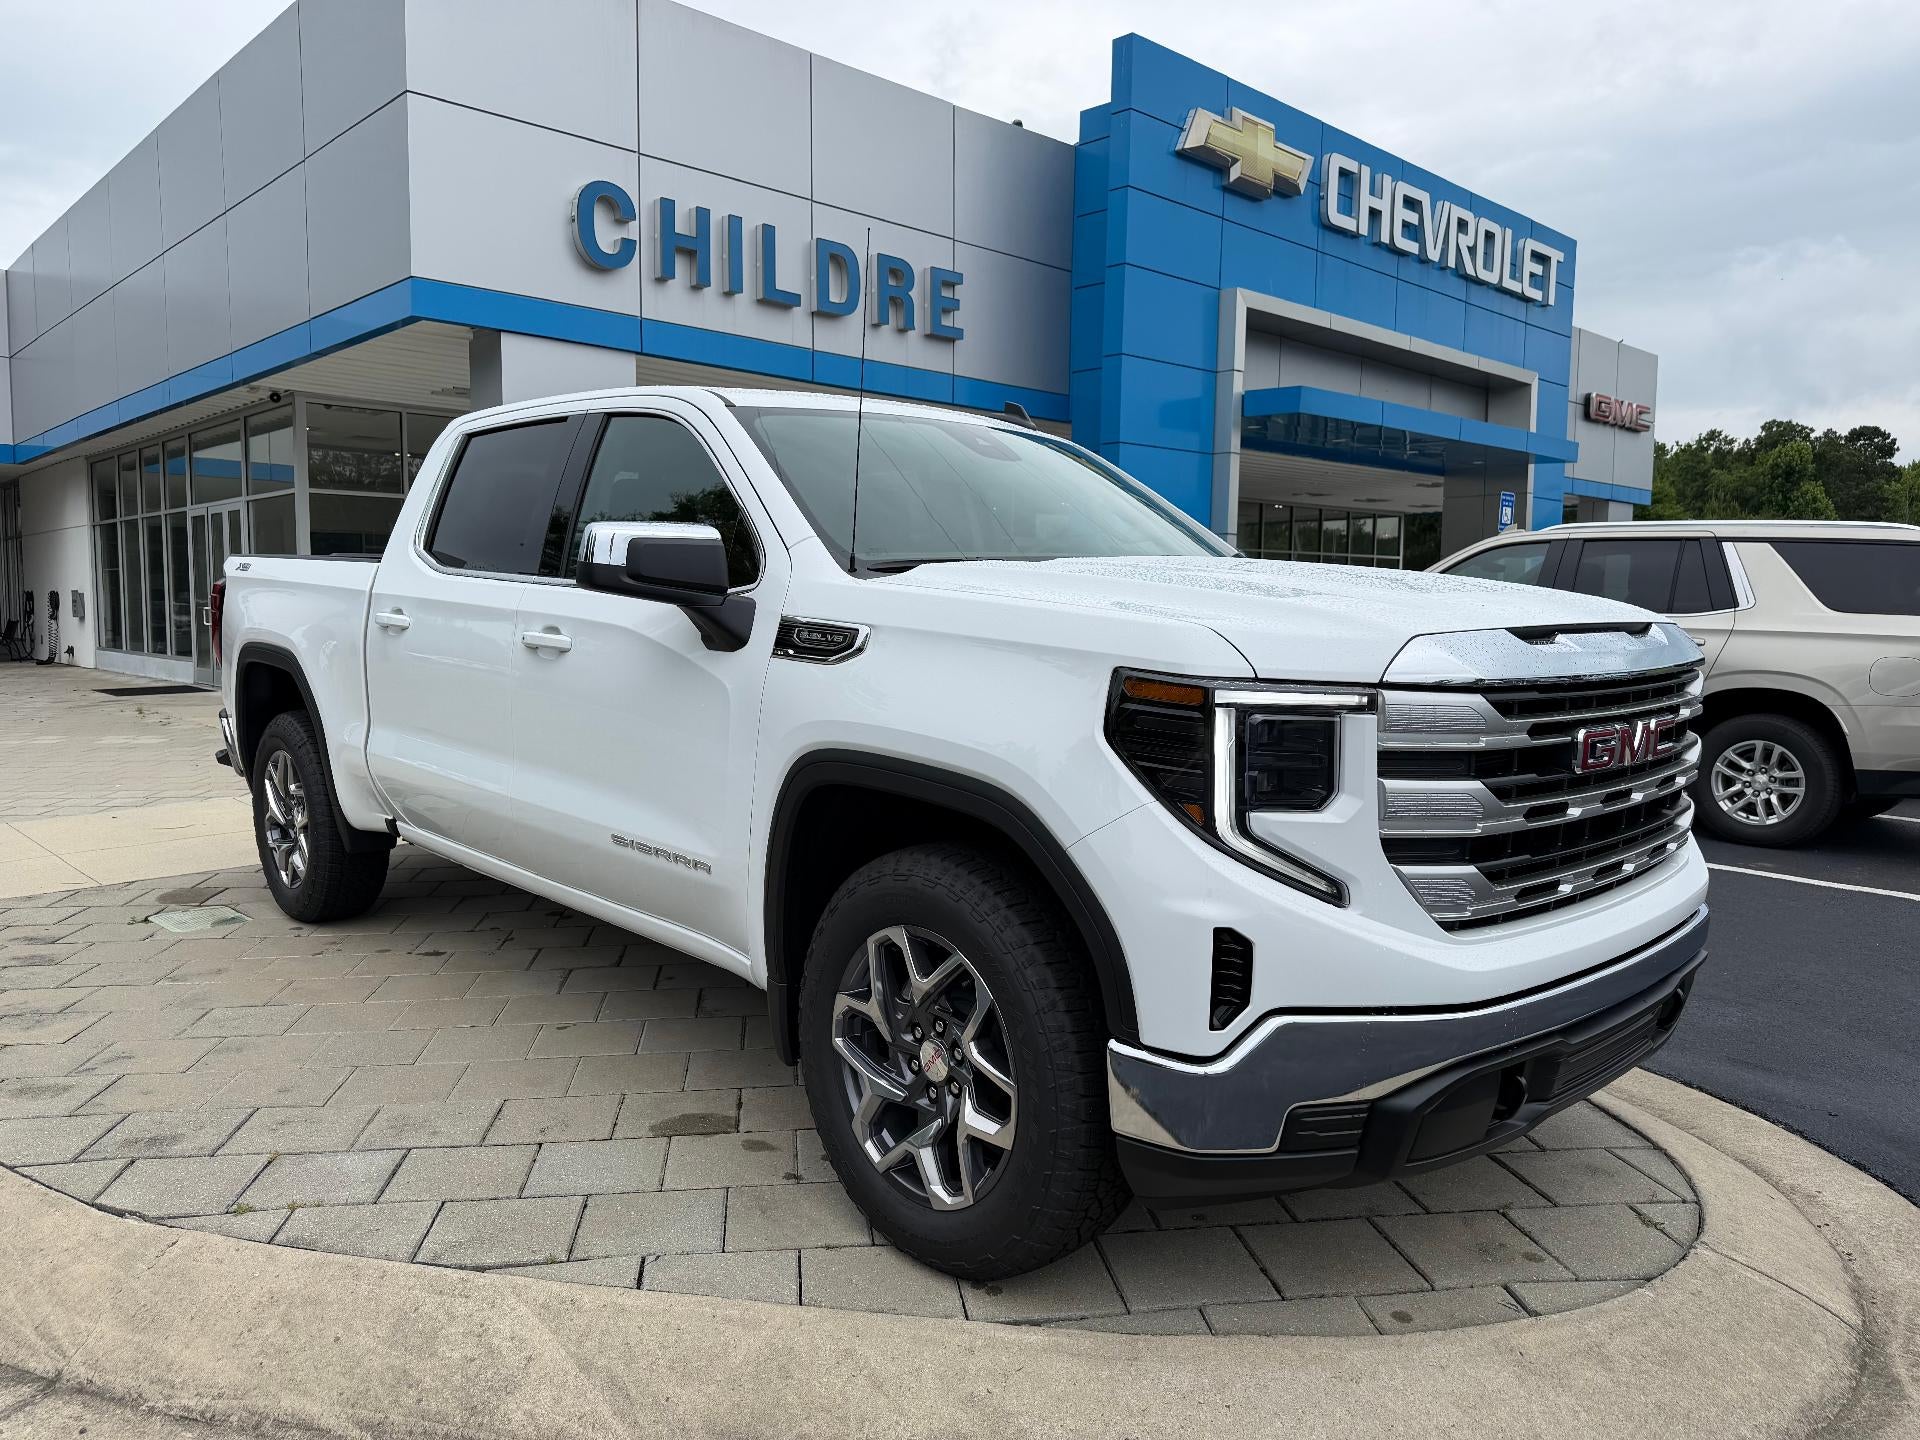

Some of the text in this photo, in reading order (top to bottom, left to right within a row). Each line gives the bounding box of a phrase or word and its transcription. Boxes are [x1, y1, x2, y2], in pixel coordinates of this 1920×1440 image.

[1321, 152, 1565, 306] CHEVROLET
[572, 180, 964, 341] CHILDRE
[1584, 391, 1651, 432] GMC
[1575, 716, 1678, 774] GMC
[610, 833, 713, 875] SIERRA
[923, 1047, 943, 1073] GMC
